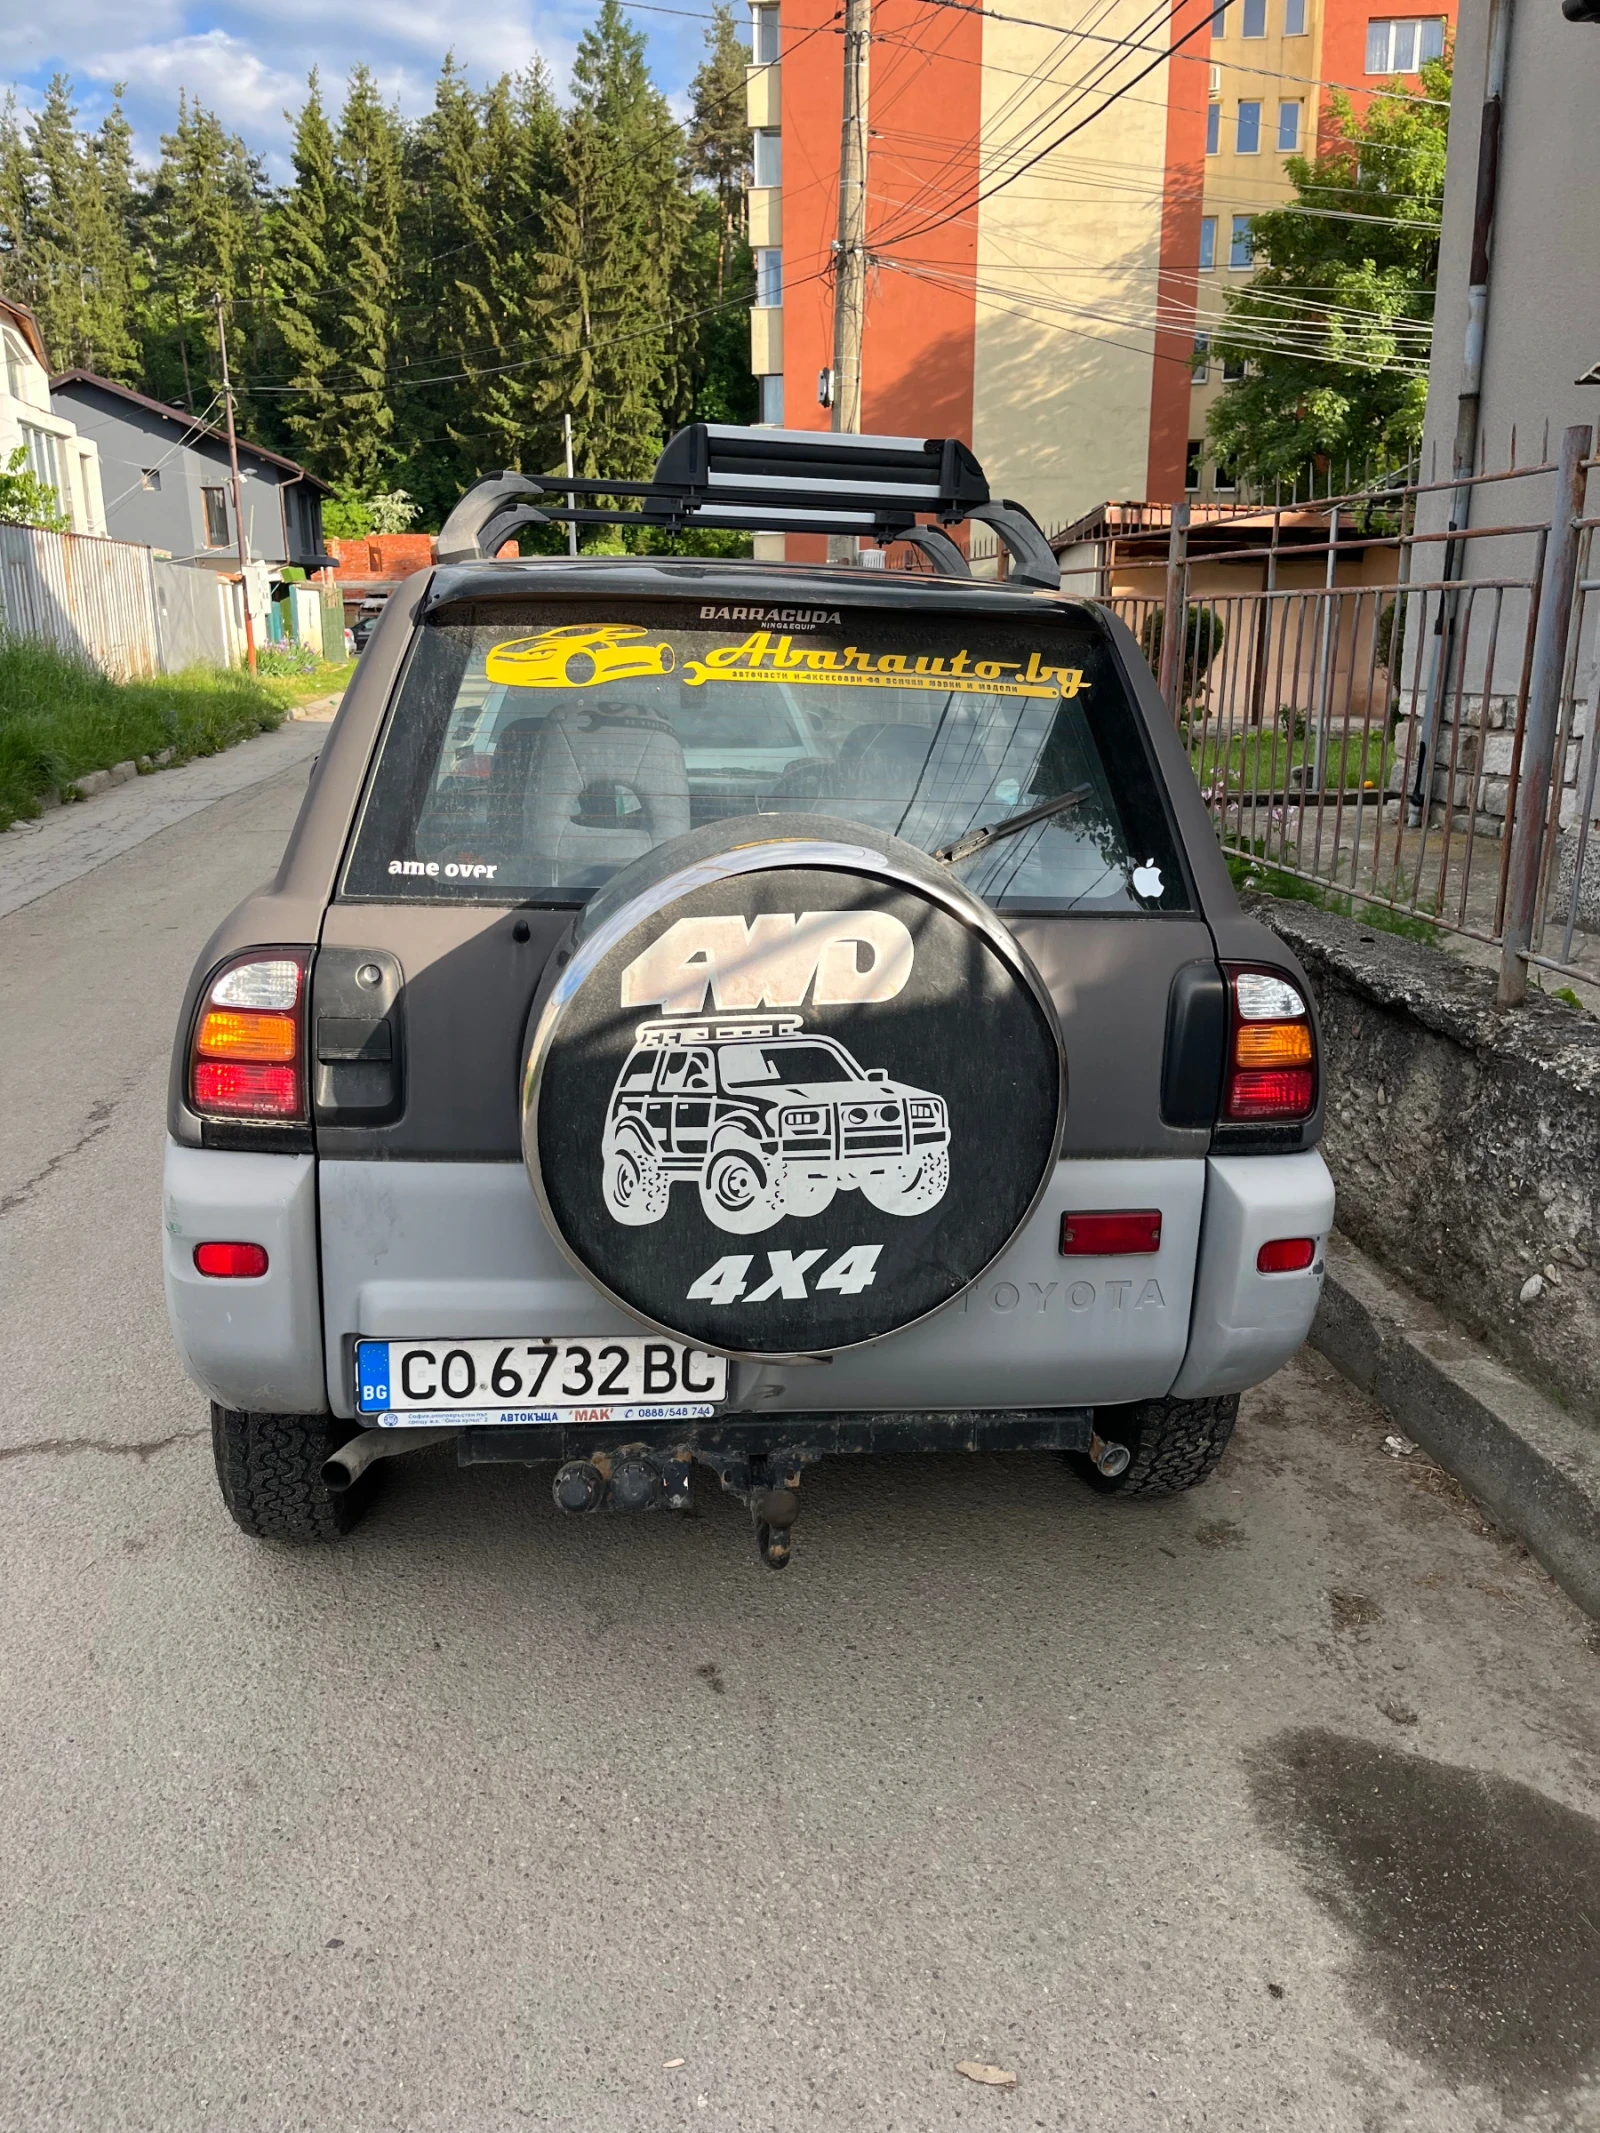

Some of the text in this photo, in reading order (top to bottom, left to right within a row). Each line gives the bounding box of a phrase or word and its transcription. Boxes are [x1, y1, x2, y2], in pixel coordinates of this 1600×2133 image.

[700, 606, 841, 624] BARRACUDA
[705, 630, 1092, 699] Abarauto.bg
[388, 860, 498, 878] ame over
[621, 910, 914, 1014] 4WD
[686, 1245, 884, 1305] 4X4
[363, 1385, 388, 1401] BG
[500, 1412, 558, 1423] АВТОКЪЩА
[638, 1407, 688, 1418] 0888/548
